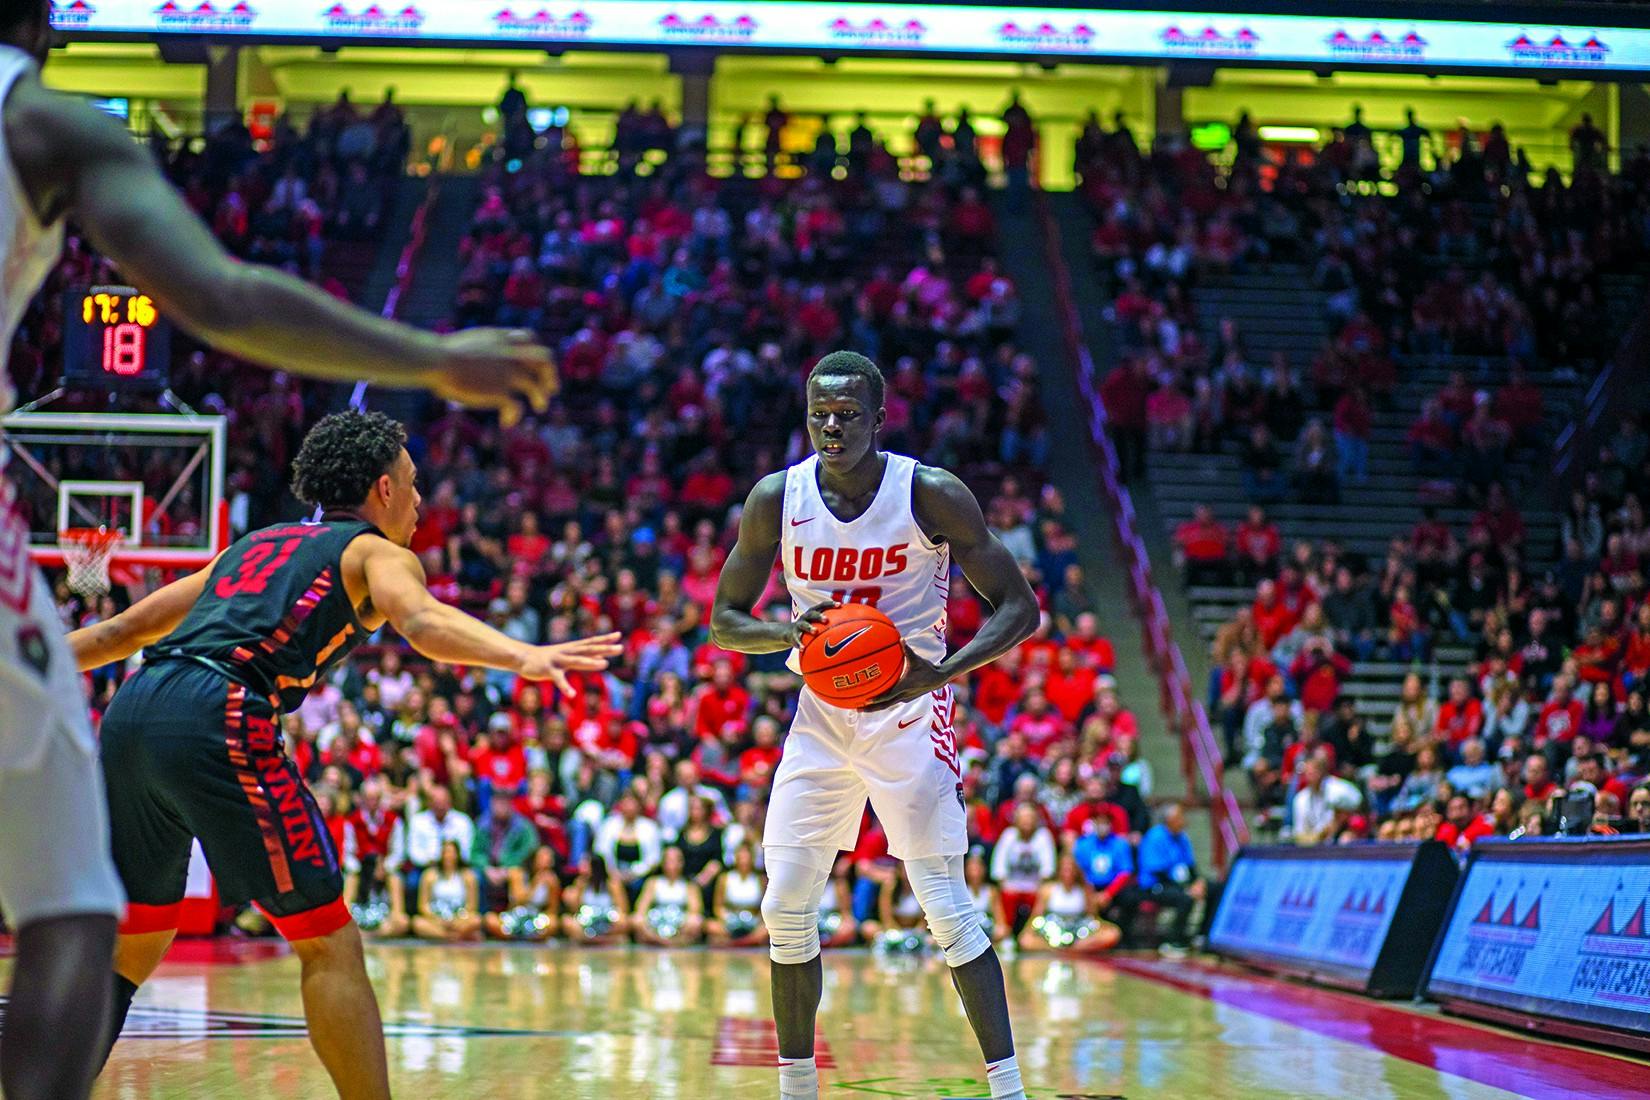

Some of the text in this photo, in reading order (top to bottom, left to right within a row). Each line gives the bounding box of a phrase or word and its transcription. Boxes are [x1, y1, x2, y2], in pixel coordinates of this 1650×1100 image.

[83, 293, 157, 327] 17:16
[103, 323, 145, 376] 18
[215, 537, 304, 598] 31
[794, 543, 909, 581] LOBOS
[832, 664, 882, 689] ELITE
